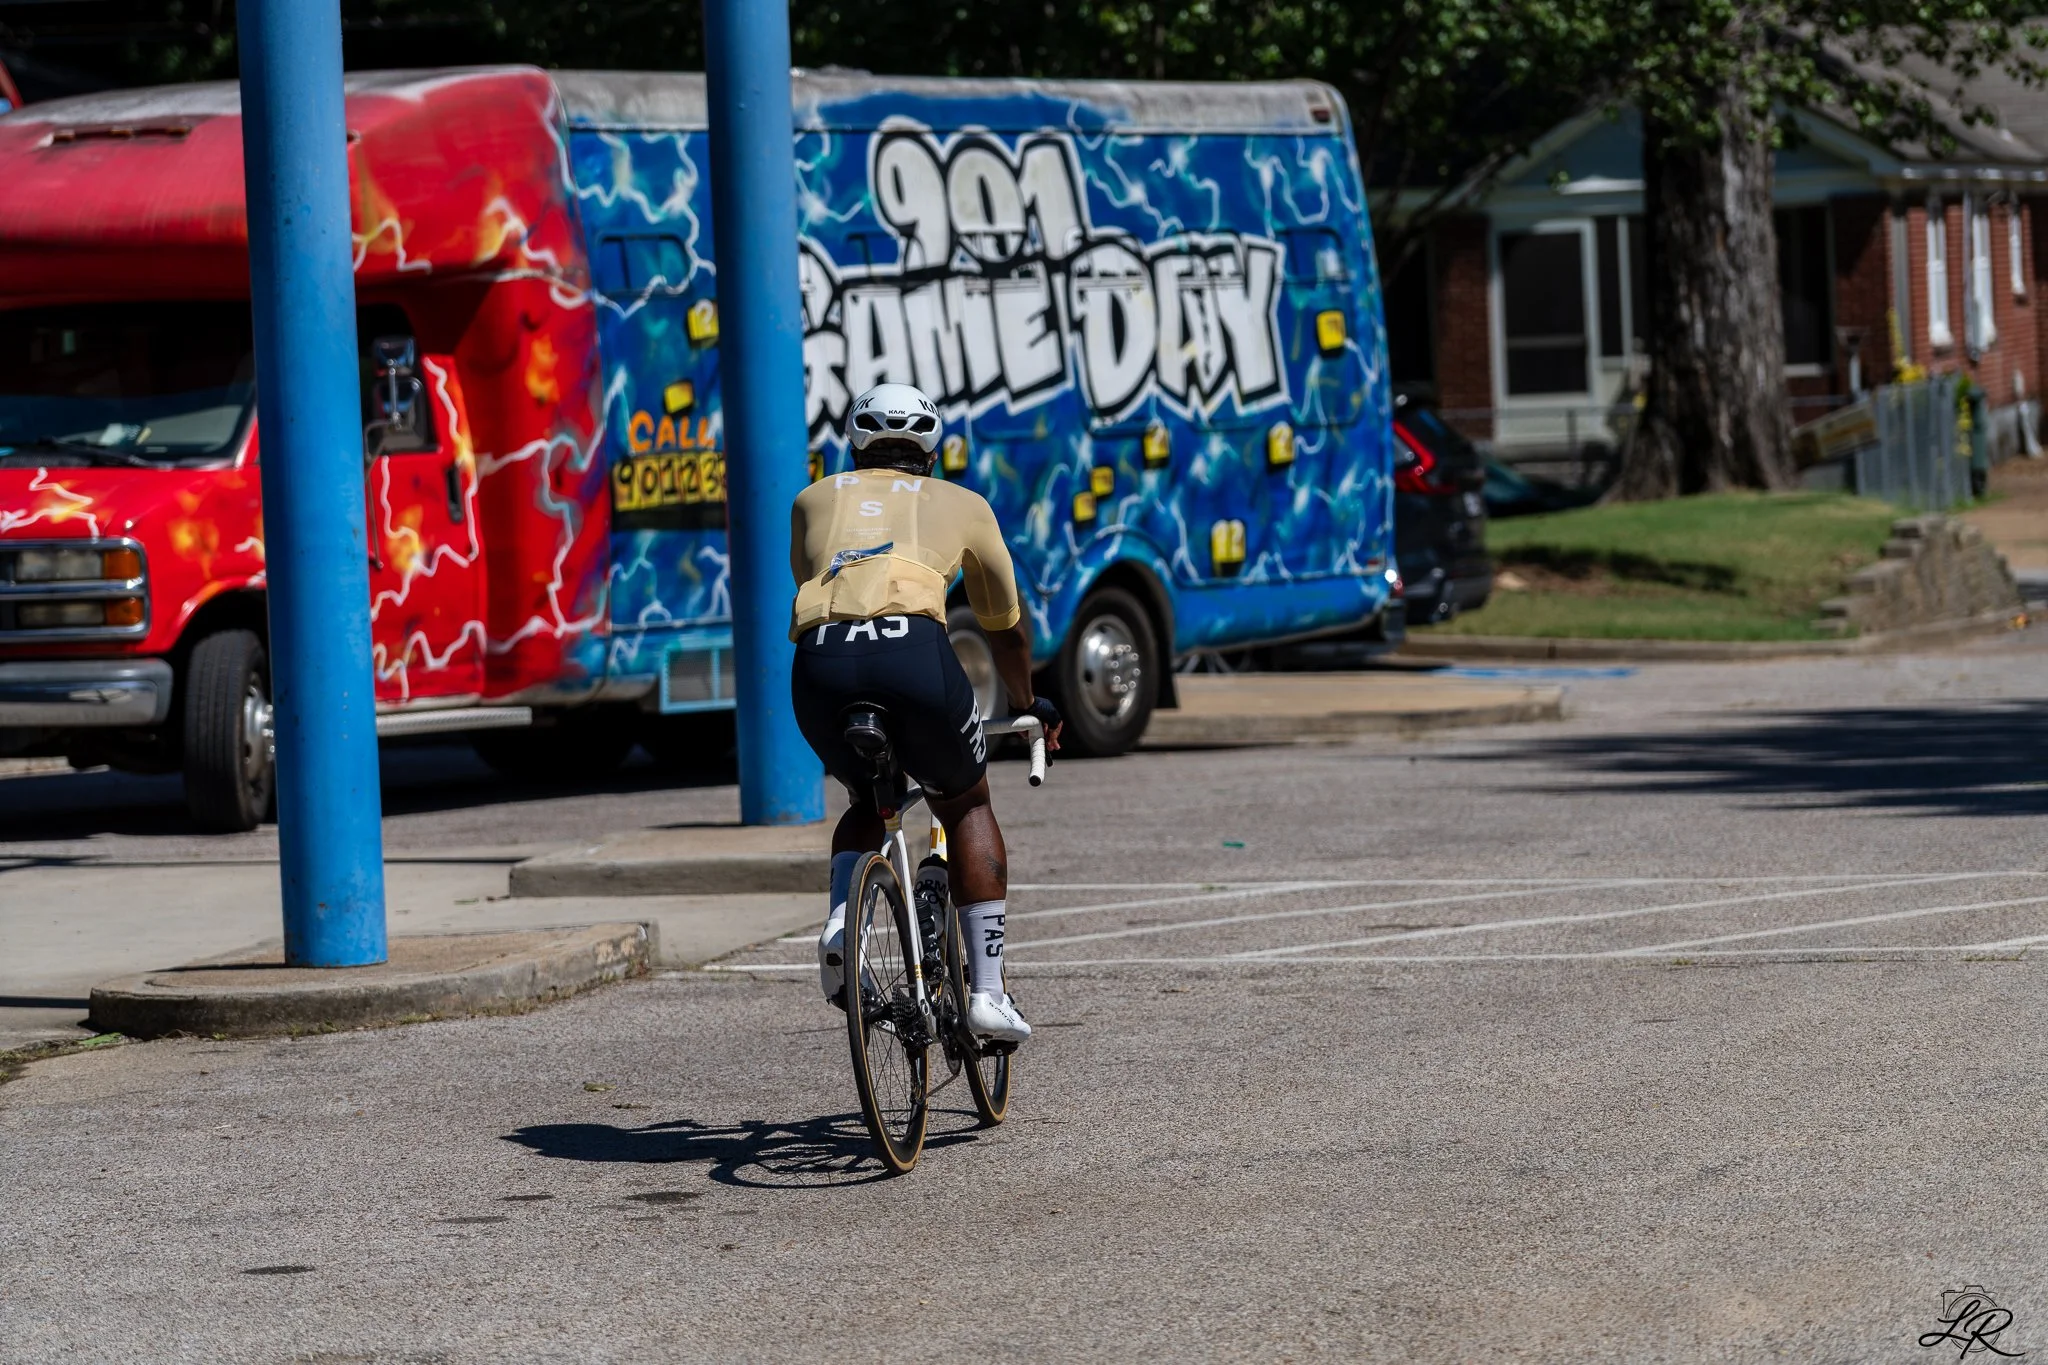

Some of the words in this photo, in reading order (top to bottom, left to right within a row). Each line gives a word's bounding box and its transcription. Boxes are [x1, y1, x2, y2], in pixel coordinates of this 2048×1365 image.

[869, 116, 1091, 272] 901
[1066, 228, 1290, 424] DAY
[628, 411, 716, 453] CALL
[834, 476, 860, 489] P
[891, 479, 922, 493] N
[858, 501, 883, 517] S
[982, 914, 1005, 957] PAS
